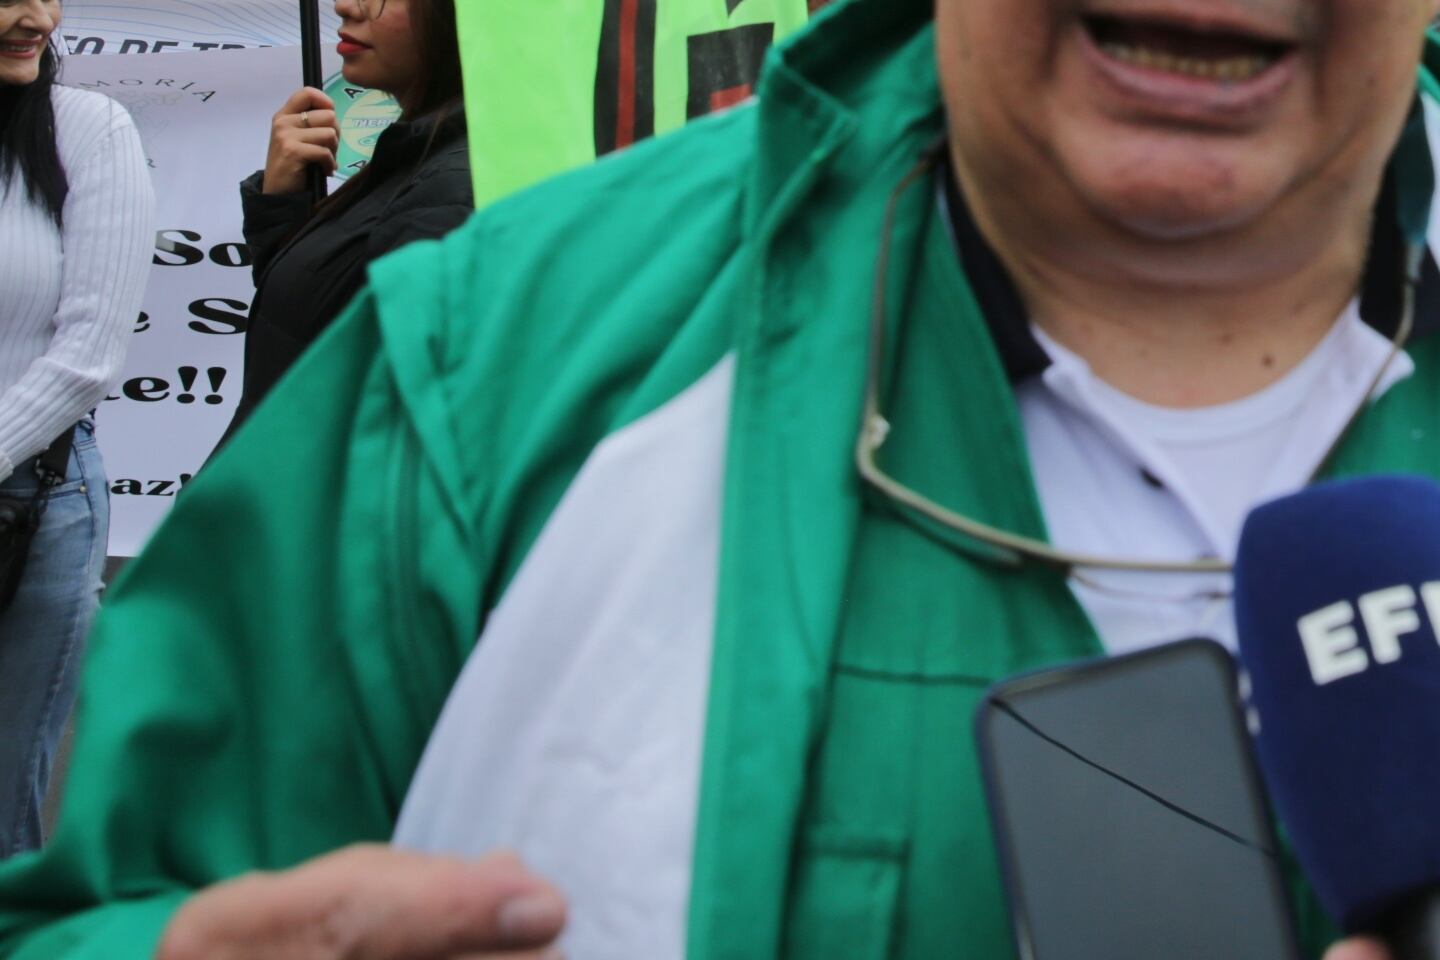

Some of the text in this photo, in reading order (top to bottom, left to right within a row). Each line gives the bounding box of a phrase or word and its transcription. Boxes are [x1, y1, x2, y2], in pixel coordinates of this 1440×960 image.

[79, 77, 216, 102] MORIA
[152, 229, 253, 267] So
[105, 366, 227, 405] e!!
